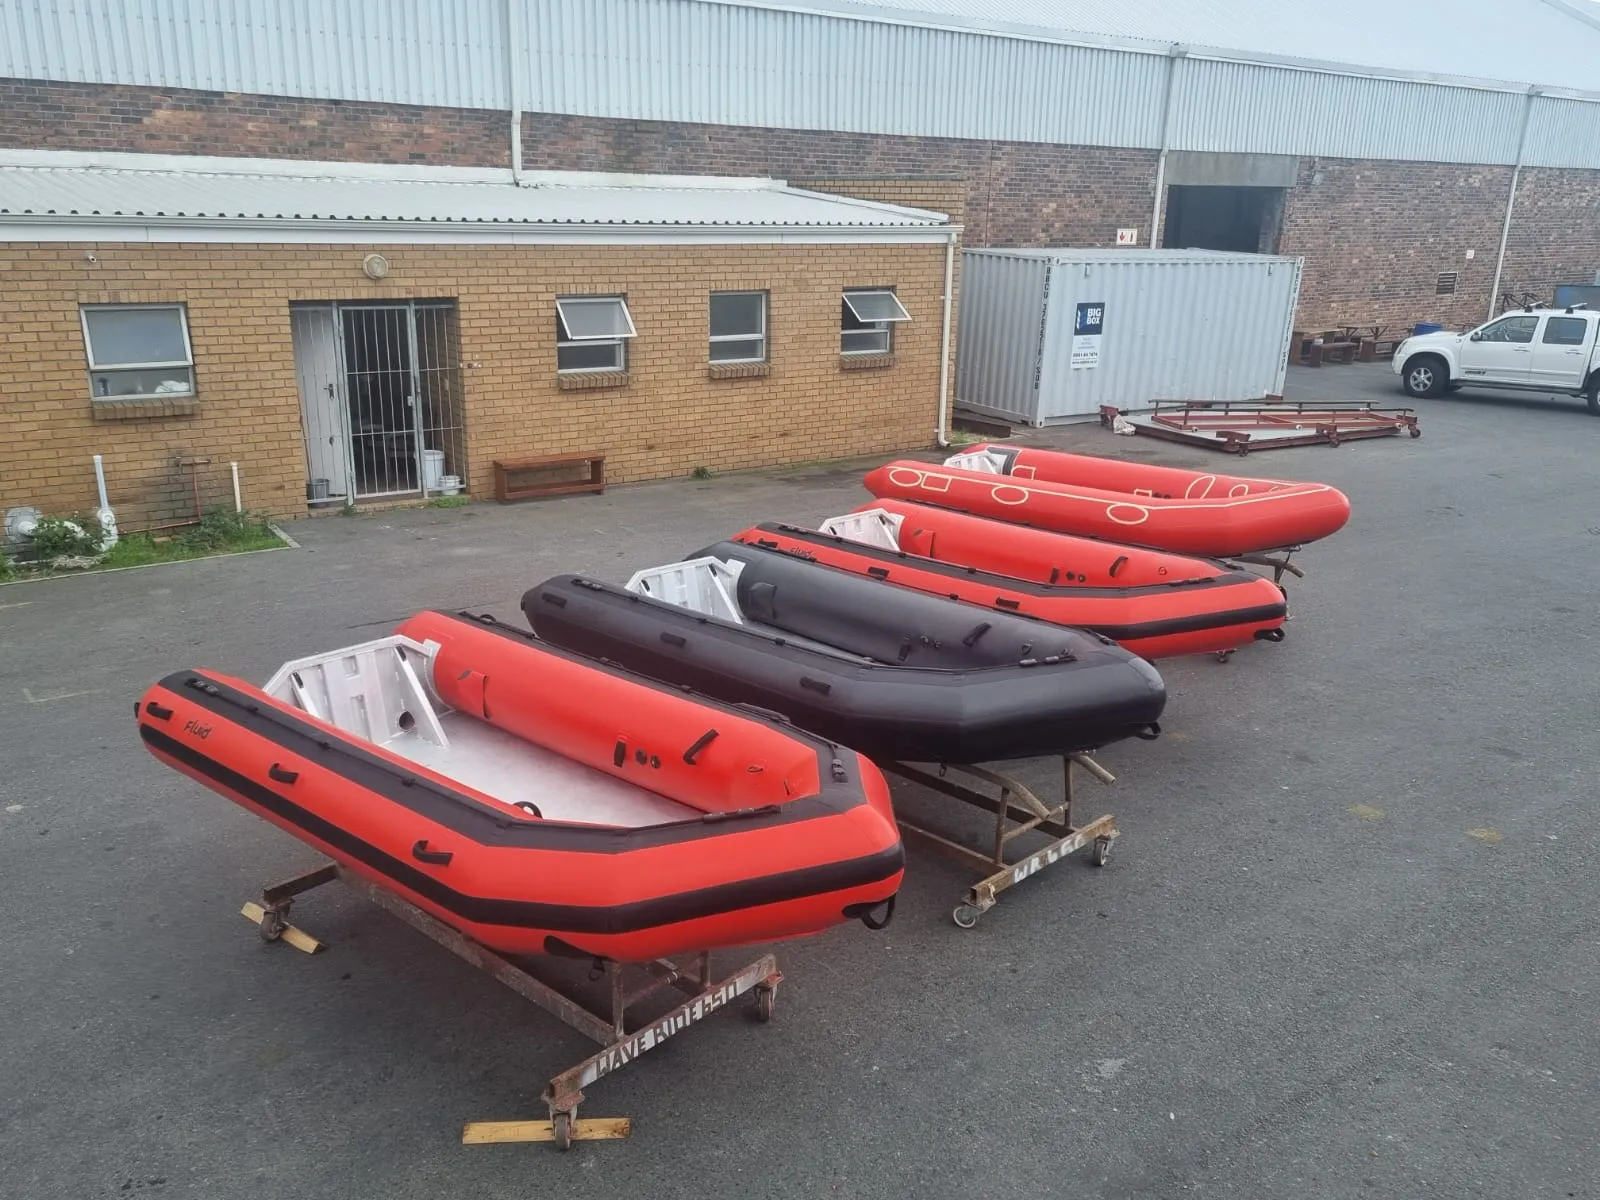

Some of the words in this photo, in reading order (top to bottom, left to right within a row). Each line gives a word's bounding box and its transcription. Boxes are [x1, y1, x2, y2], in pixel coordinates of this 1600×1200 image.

[1087, 308, 1102, 317] BIG
[1086, 316, 1101, 325] BOX
[183, 719, 212, 739] Fluid
[596, 1034, 648, 1078] WAVE
